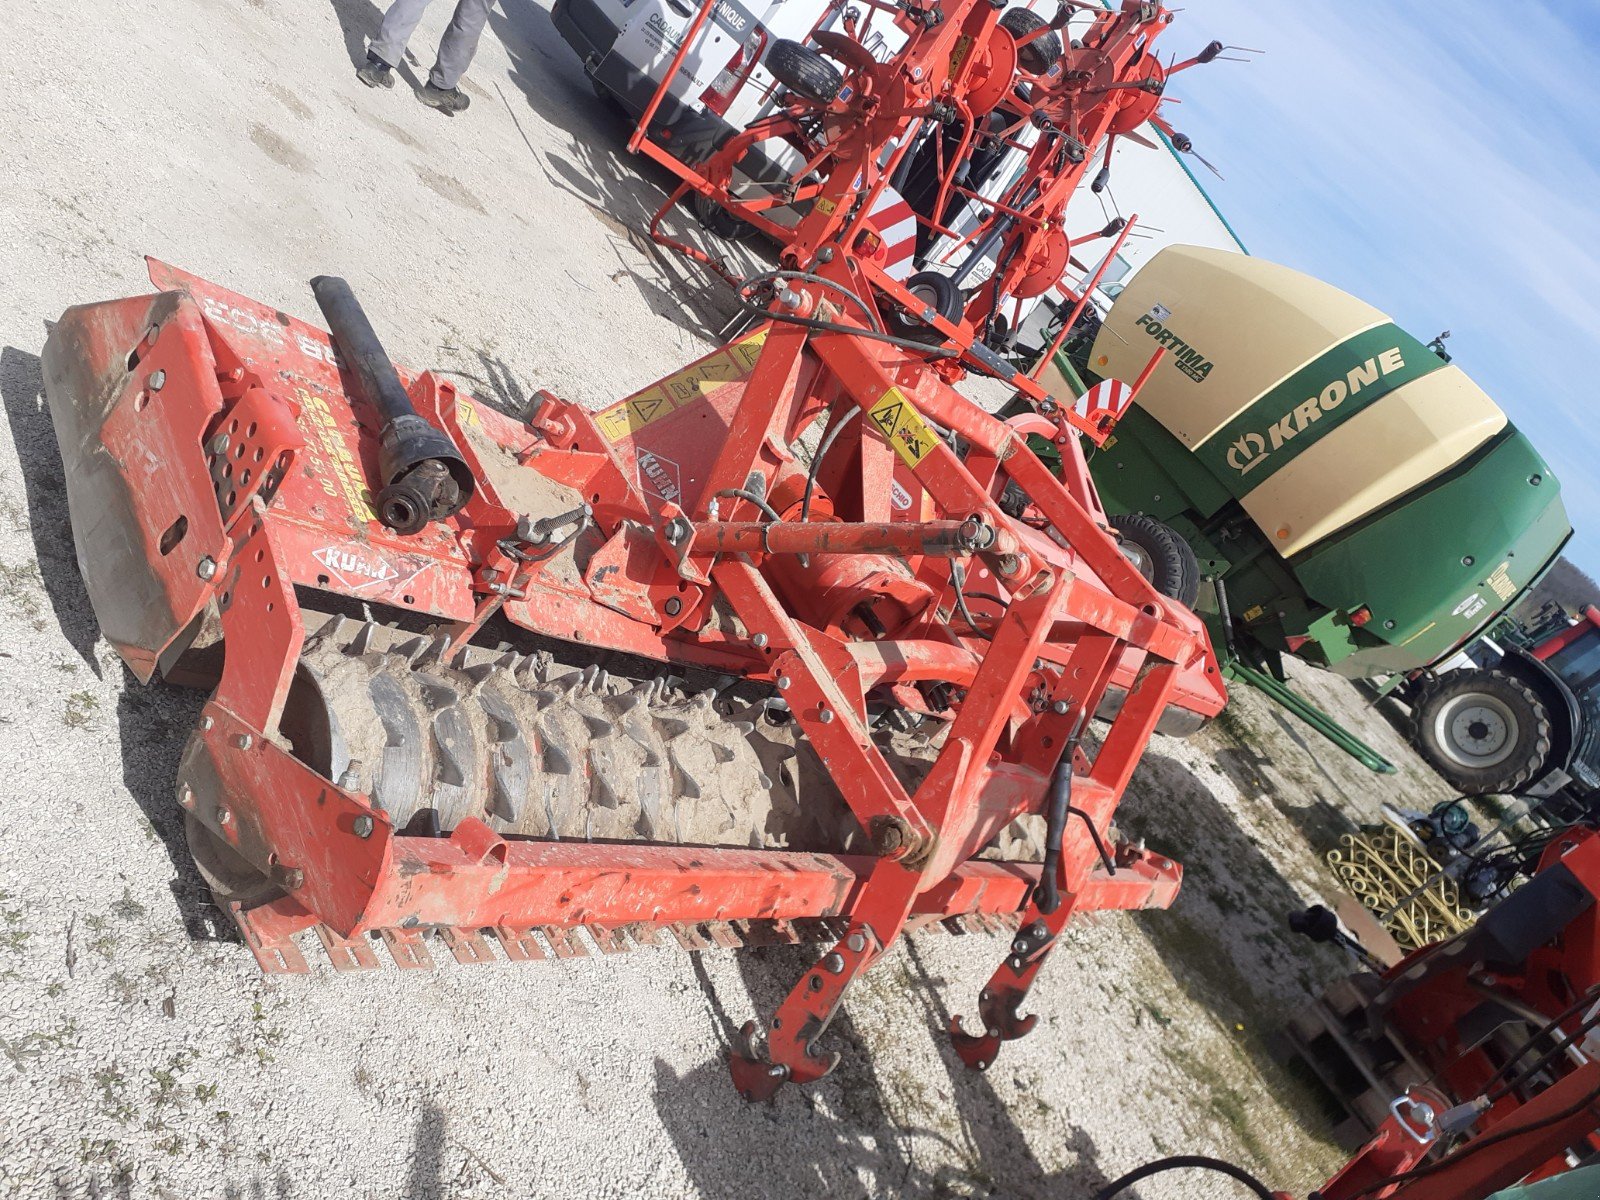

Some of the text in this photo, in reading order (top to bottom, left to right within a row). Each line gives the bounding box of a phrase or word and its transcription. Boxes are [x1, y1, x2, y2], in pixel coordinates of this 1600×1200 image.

[680, 66, 704, 88] RENAULT
[1135, 313, 1214, 378] FORTIMA
[1268, 347, 1405, 450] KRONE
[638, 453, 679, 500] KUHN
